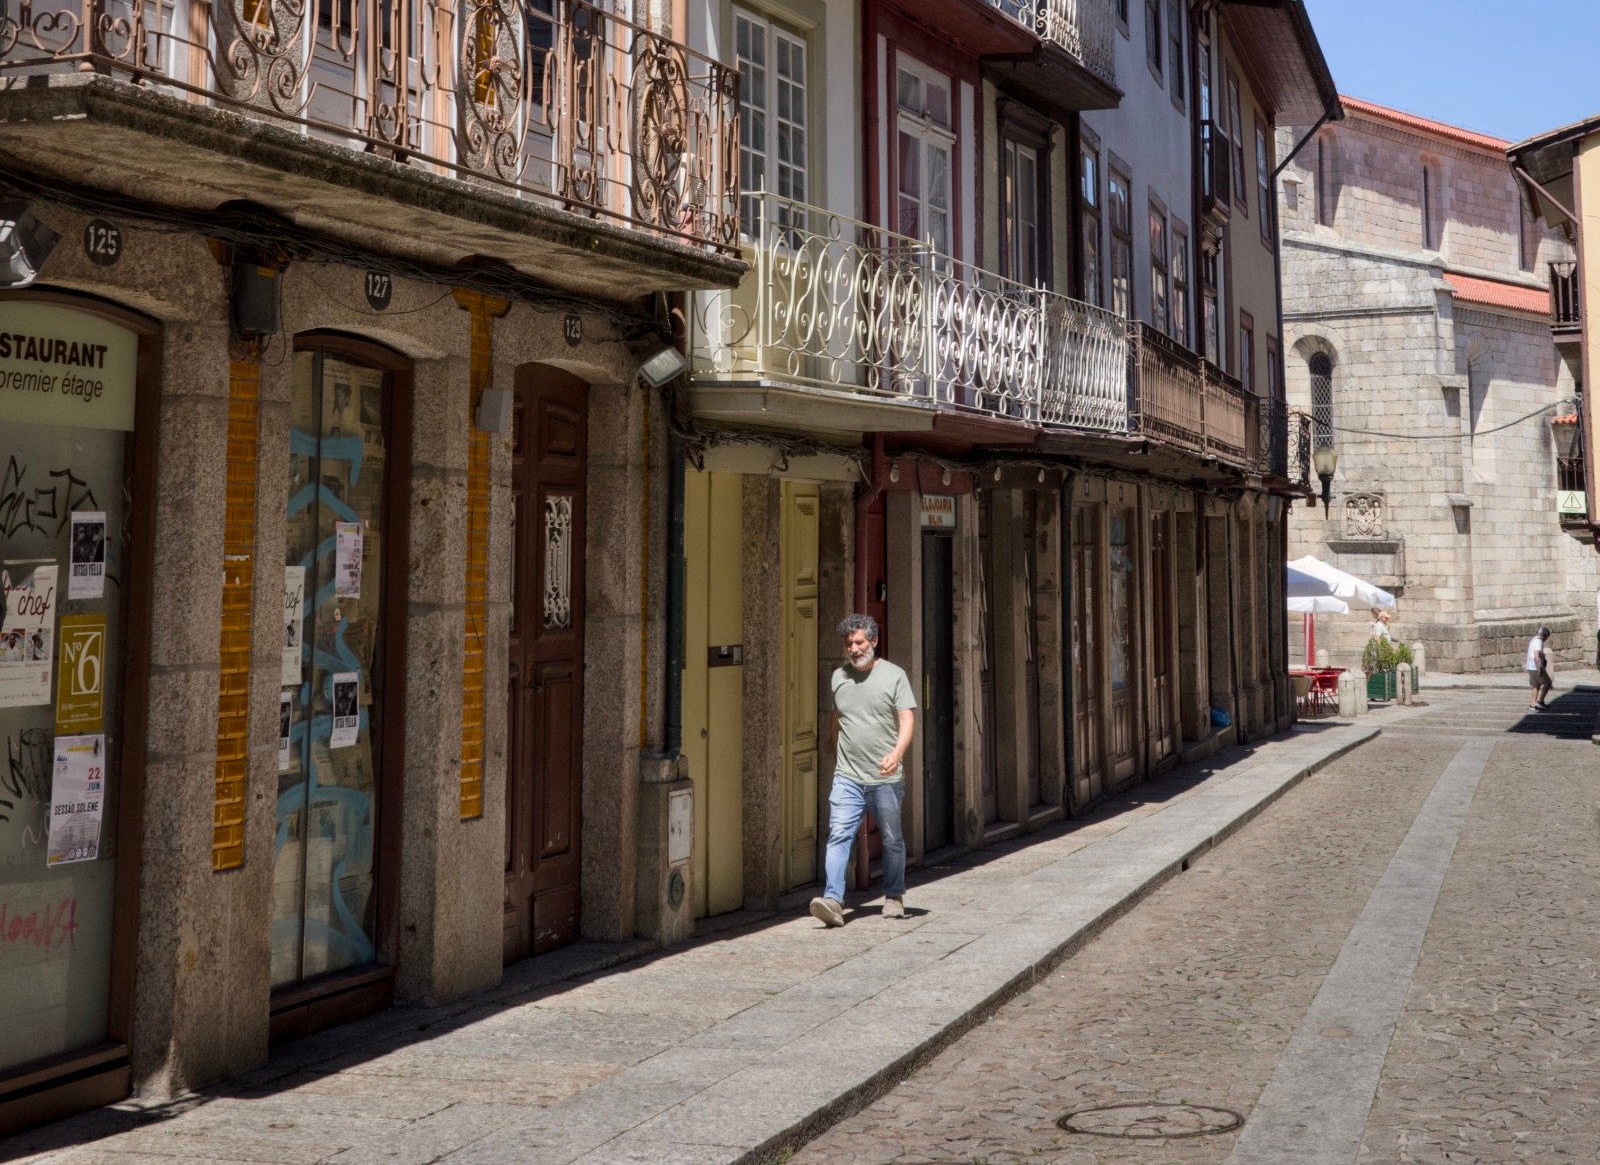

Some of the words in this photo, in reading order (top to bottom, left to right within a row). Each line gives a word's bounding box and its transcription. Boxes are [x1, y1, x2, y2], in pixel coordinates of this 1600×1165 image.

[88, 225, 117, 256] 125
[367, 273, 389, 298] 127
[566, 318, 582, 339] 129
[62, 371, 103, 402] étage
[18, 587, 53, 623] chef
[77, 632, 102, 693] 6
[88, 767, 101, 780] 22
[86, 782, 101, 791] JUN
[54, 802, 75, 816] SESSÃO
[76, 801, 99, 814] SOLENE
